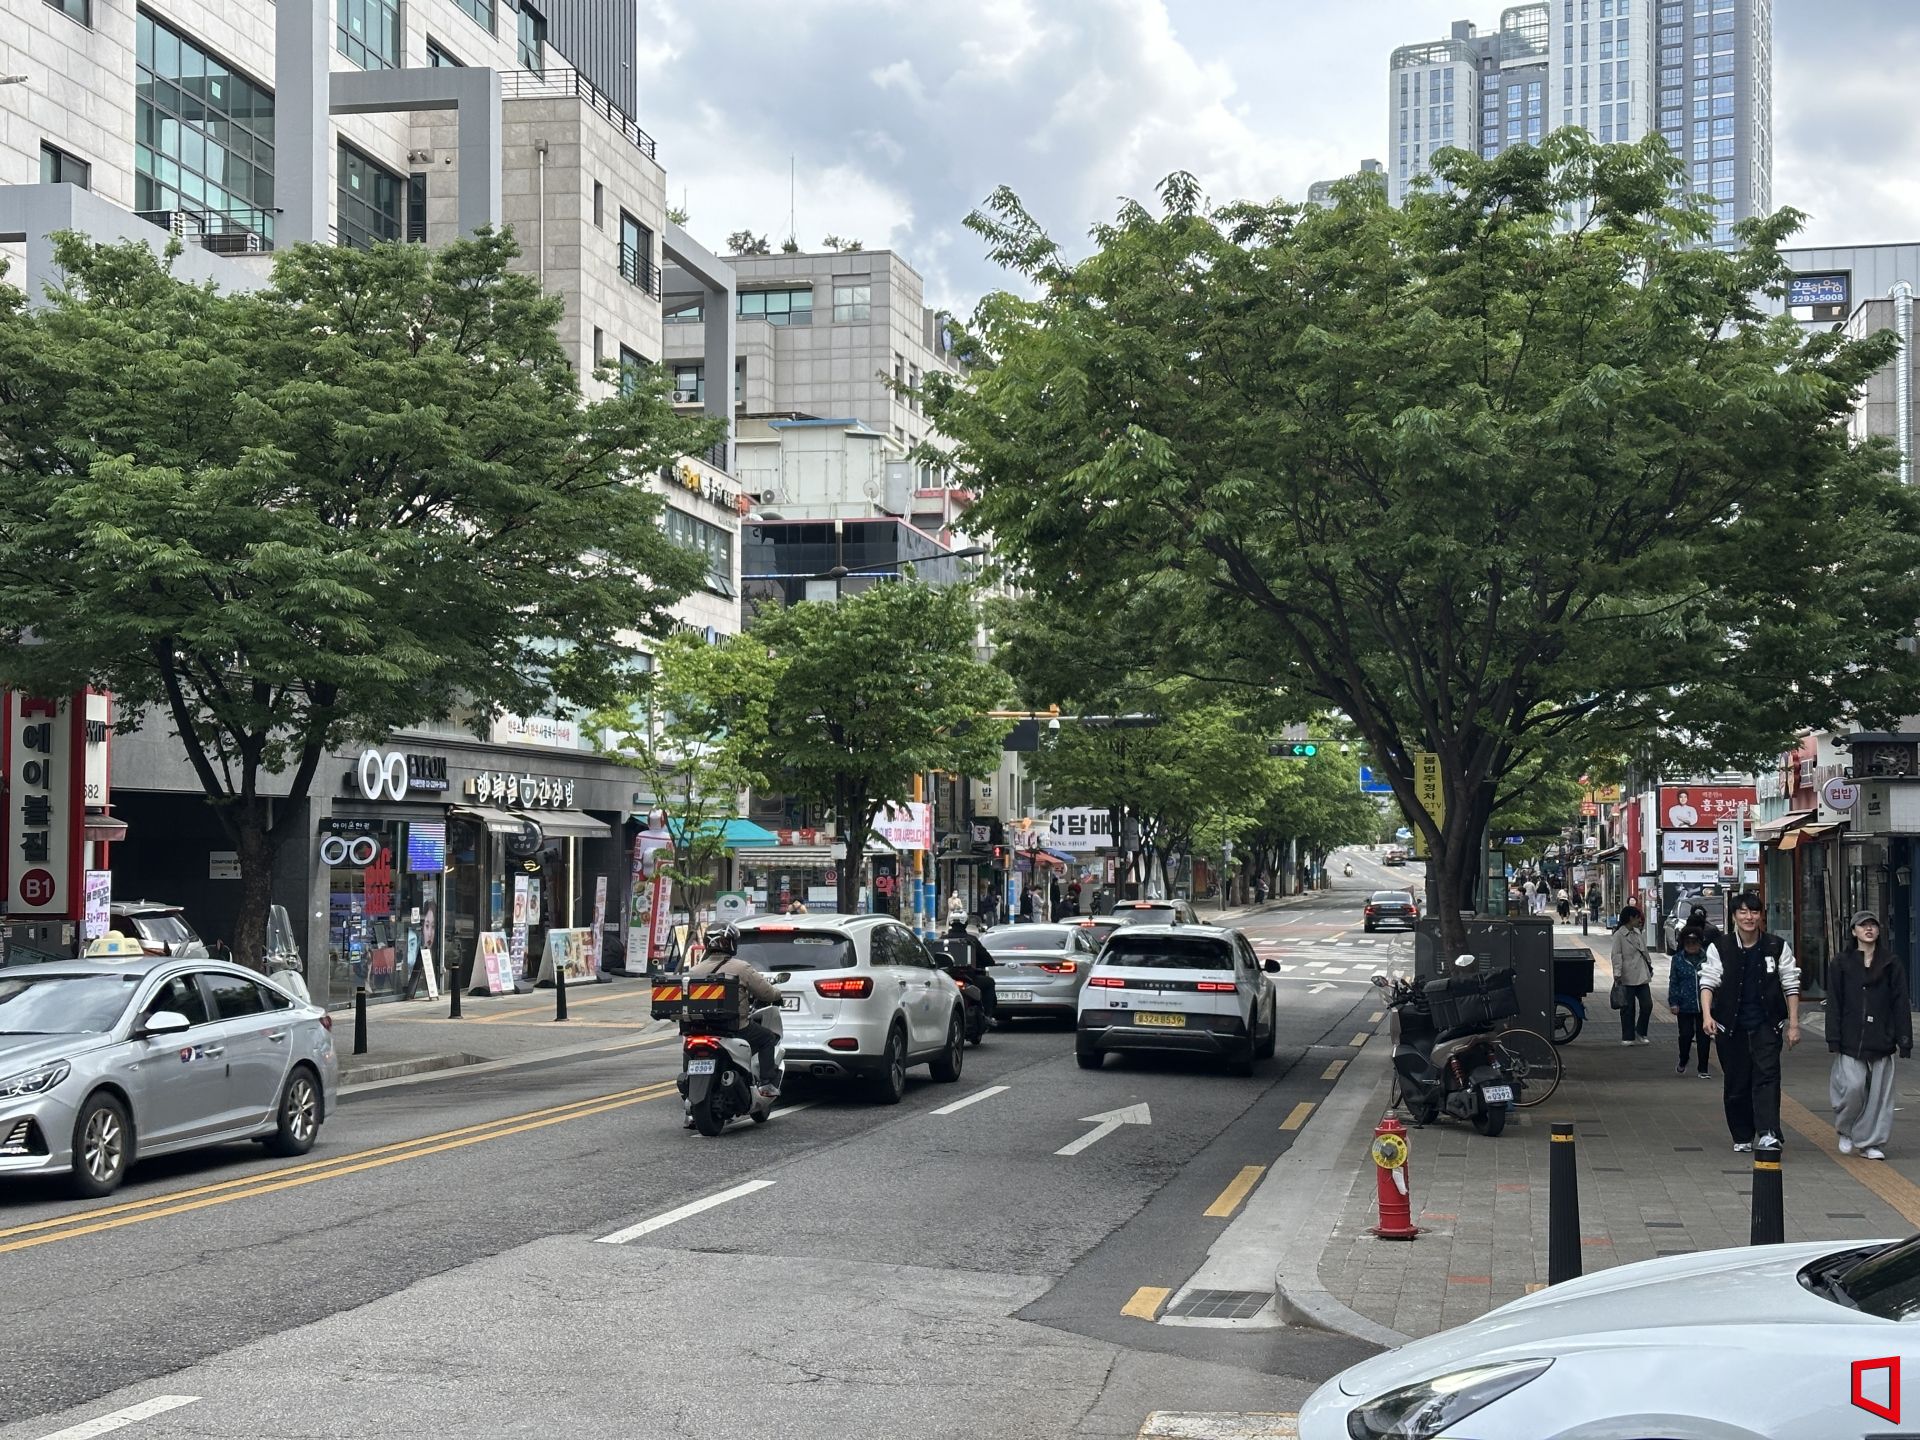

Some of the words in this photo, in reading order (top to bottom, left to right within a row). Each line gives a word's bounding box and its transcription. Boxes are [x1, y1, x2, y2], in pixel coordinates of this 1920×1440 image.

[1830, 788, 1853, 800] 컵밥
[1680, 839, 1709, 853] 계경
[26, 878, 51, 899] B1
